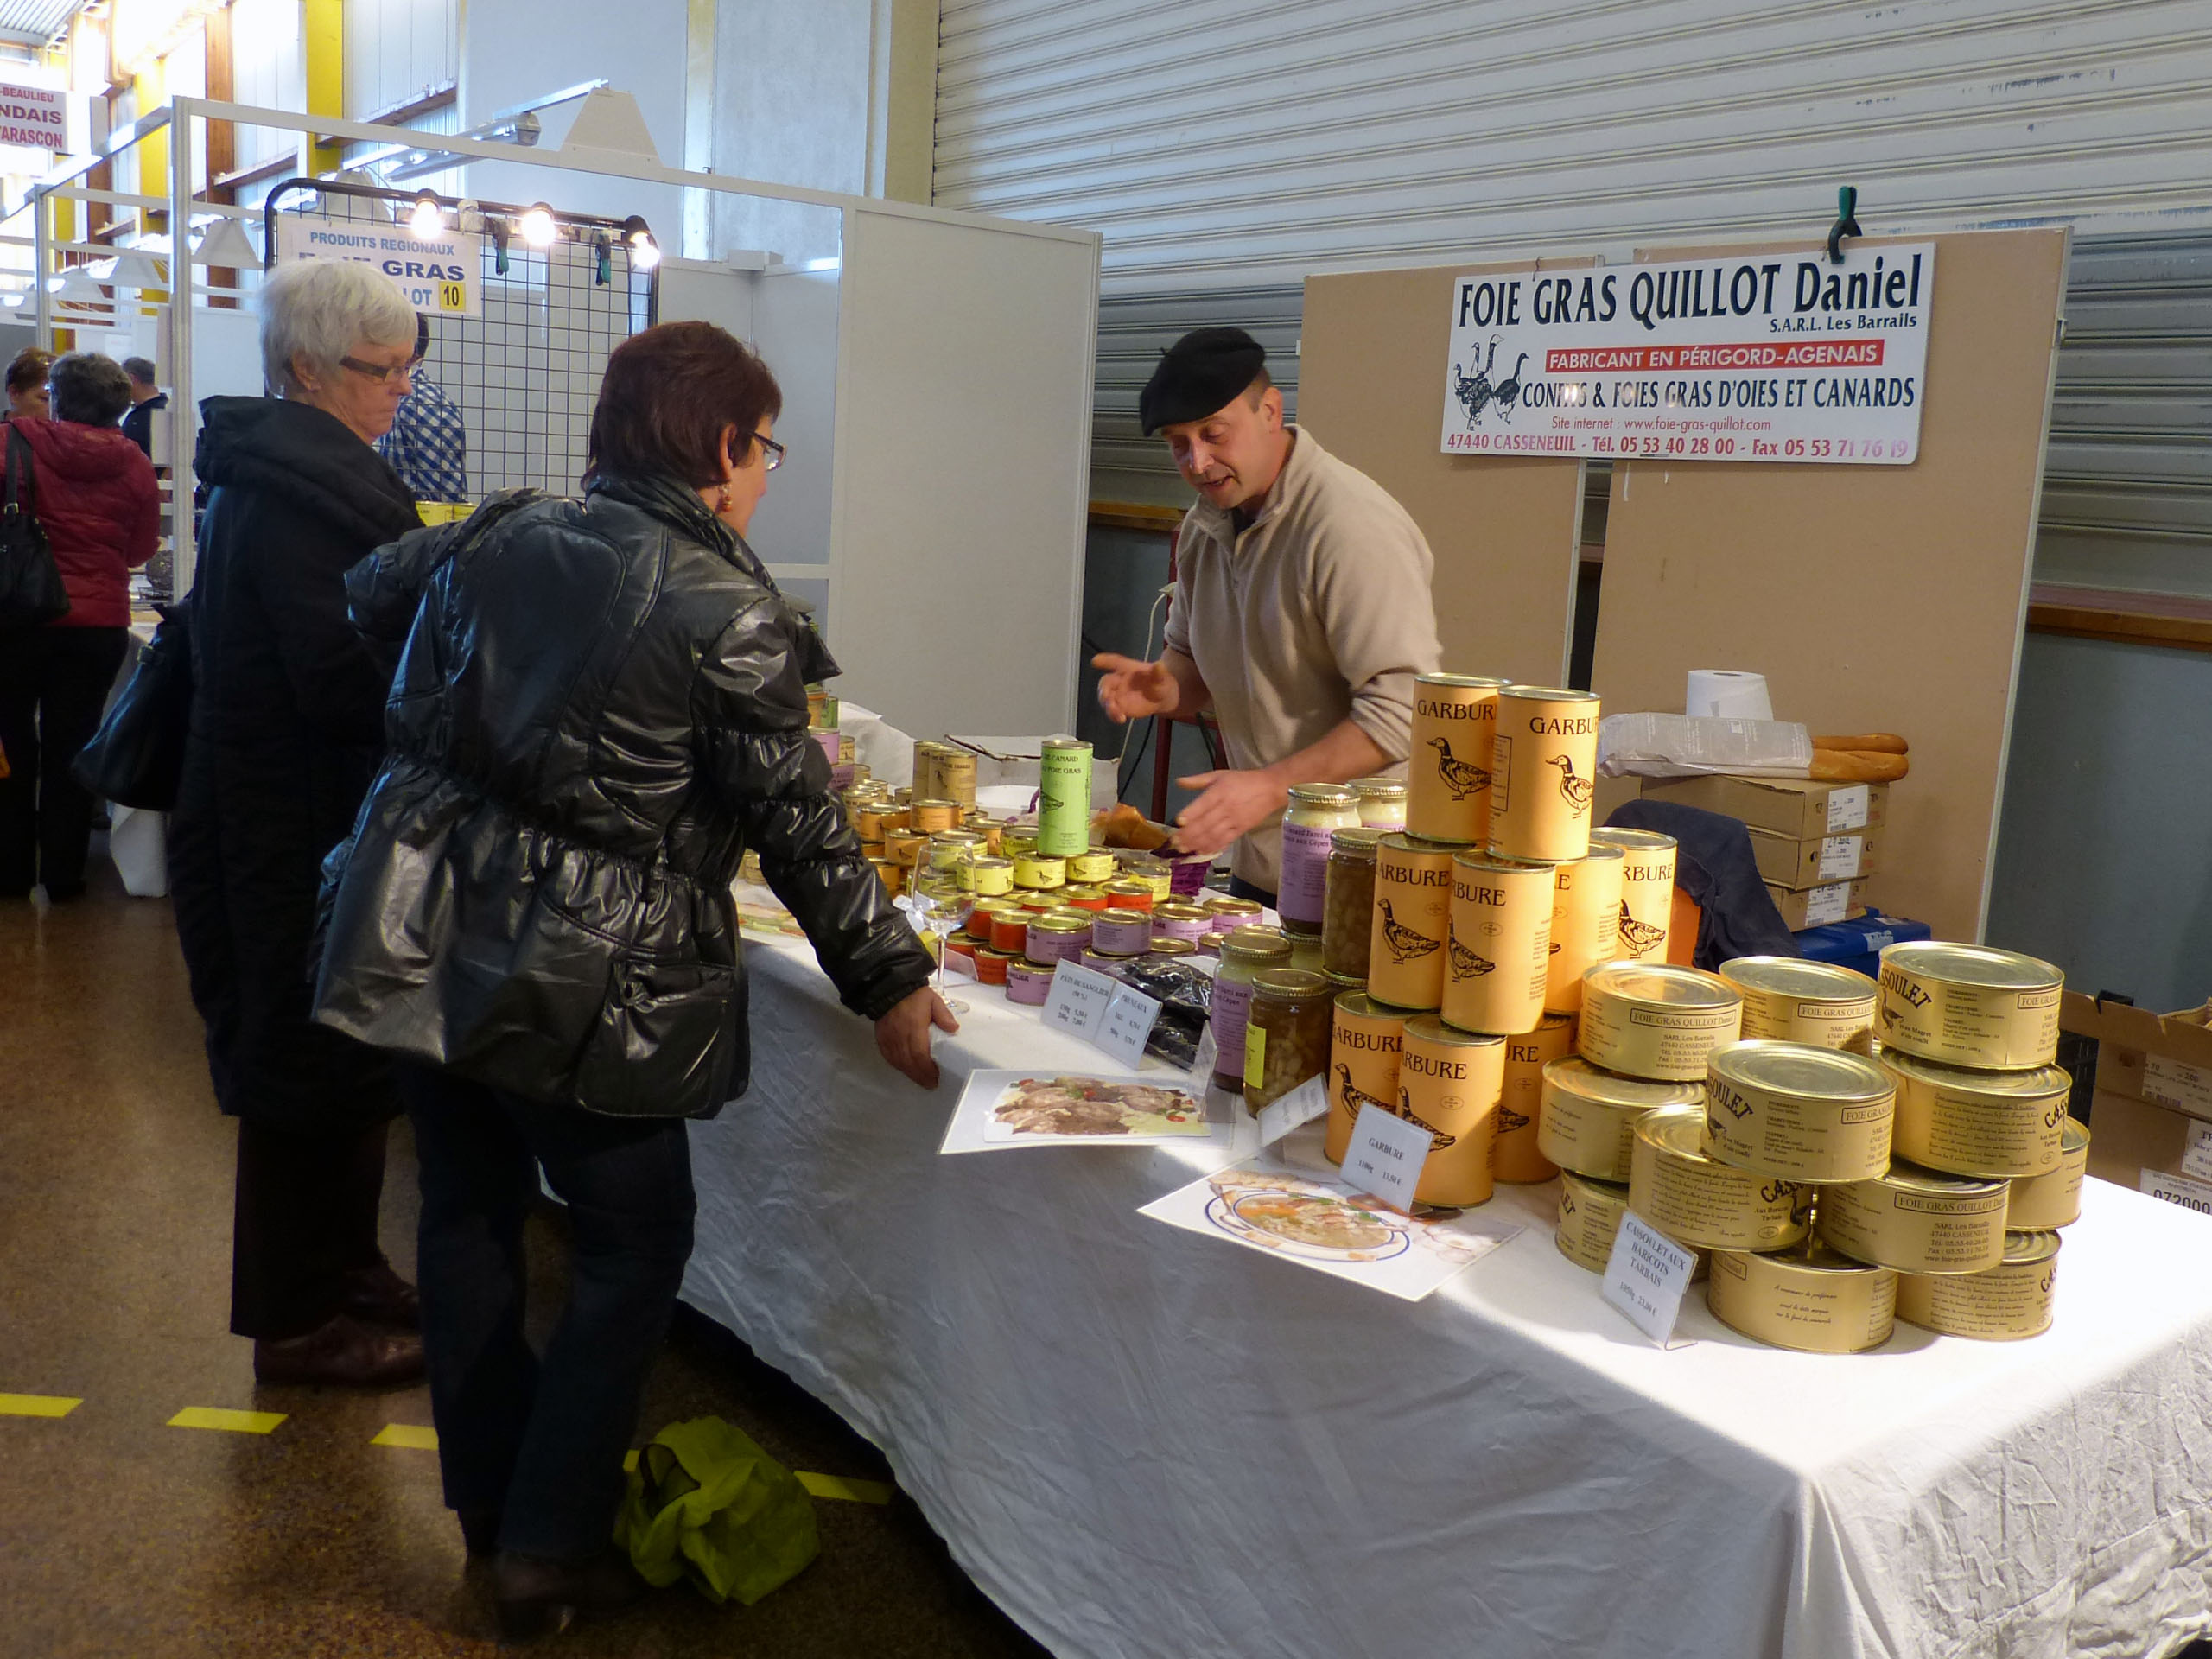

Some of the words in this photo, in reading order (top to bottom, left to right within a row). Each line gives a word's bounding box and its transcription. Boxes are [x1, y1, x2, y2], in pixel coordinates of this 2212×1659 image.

[0, 125, 62, 148] ARASCON
[310, 232, 376, 248] PRODUITS
[380, 238, 454, 256] REGIONAUX
[382, 260, 465, 281] GRAS
[444, 285, 460, 306] 10
[1459, 281, 1521, 327] FOIE
[1533, 274, 1617, 325] GRAS
[1630, 264, 1782, 330] QUILLOT
[1793, 253, 1922, 313] Daniel
[1770, 316, 1821, 333] S.A.R.L.
[1827, 315, 1851, 330] Les
[1857, 312, 1917, 329] Barrails
[1549, 351, 1643, 369] FABRICANT
[1649, 350, 1674, 367] EN
[1679, 343, 1877, 366] PÉRIGORD-AGENAIS
[1592, 380, 1606, 408] &
[1612, 380, 1659, 408] FOIES
[1665, 379, 1712, 408] GRAS
[1718, 378, 1778, 408] D'OIES
[1784, 378, 1807, 407] ET
[1814, 377, 1915, 408] CANARDS
[1552, 416, 1571, 429] Site
[1573, 416, 1613, 429] internet
[1624, 415, 1771, 434] www.foie-gras-quillot.com
[1446, 434, 1489, 449] 47440
[1493, 435, 1576, 451] CASSENEUIL
[1592, 435, 1615, 452] Tél.
[1620, 437, 1637, 453] 05
[1643, 437, 1660, 453] 53
[1665, 437, 1685, 454] 40
[1690, 437, 1709, 454] 28
[1714, 438, 1734, 454] 00
[1752, 440, 1777, 455] Fax
[1784, 439, 1804, 456] 05
[1811, 439, 1831, 456] 53
[1837, 440, 1854, 457] 71
[1861, 440, 1883, 457] 76
[1633, 1012, 1654, 1023] FOIE
[1656, 1014, 1681, 1026] GRAS
[1682, 1015, 1718, 1027] QUILLOT
[1802, 1007, 1822, 1015] FOIE
[1846, 1110, 1866, 1122] FOIE
[1369, 1137, 1406, 1160] GARBURE
[1900, 1196, 1923, 1206] FOIE
[1927, 1200, 1955, 1211] GRAS
[1957, 1200, 1992, 1212] QUILLOT
[1631, 1242, 1669, 1275] HARICOTS
[1669, 1254, 1686, 1271] AUX
[1630, 1257, 1662, 1287] TARBAIS
